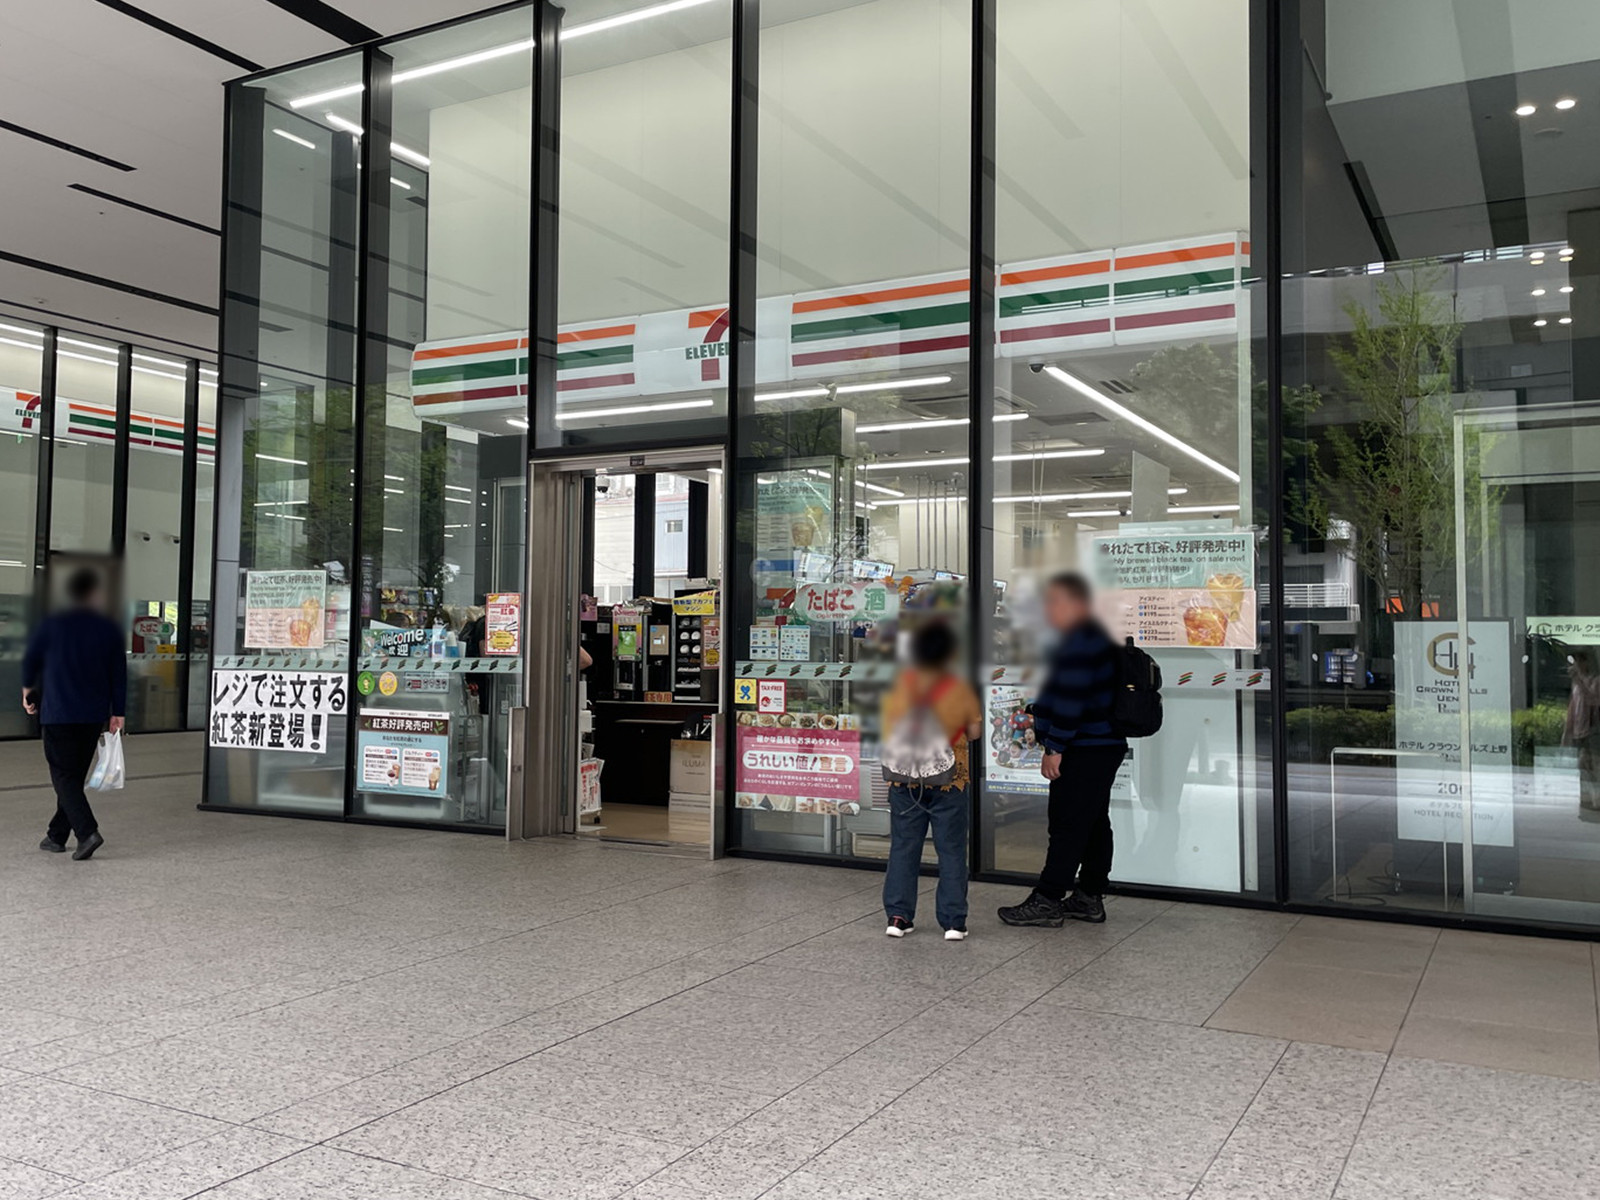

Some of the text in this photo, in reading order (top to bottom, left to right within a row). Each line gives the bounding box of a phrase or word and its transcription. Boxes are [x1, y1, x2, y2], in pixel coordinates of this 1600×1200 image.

[1127, 556, 1154, 564] brewed
[1156, 555, 1178, 563] black
[1208, 555, 1224, 563] sale
[807, 588, 886, 611] たばこ 酒
[1555, 624, 1582, 632] ホテル
[380, 629, 424, 647] Welcome
[213, 672, 346, 712] レジで注文する
[1416, 686, 1454, 694] CROWN
[211, 711, 322, 750] 紅茶新登場!
[372, 718, 433, 731] 紅茶好評発売中!
[1398, 741, 1508, 754] ホテル クラウンルズ上野
[747, 752, 848, 772] うれしい値!宣言
[1443, 809, 1494, 821] RECTION
